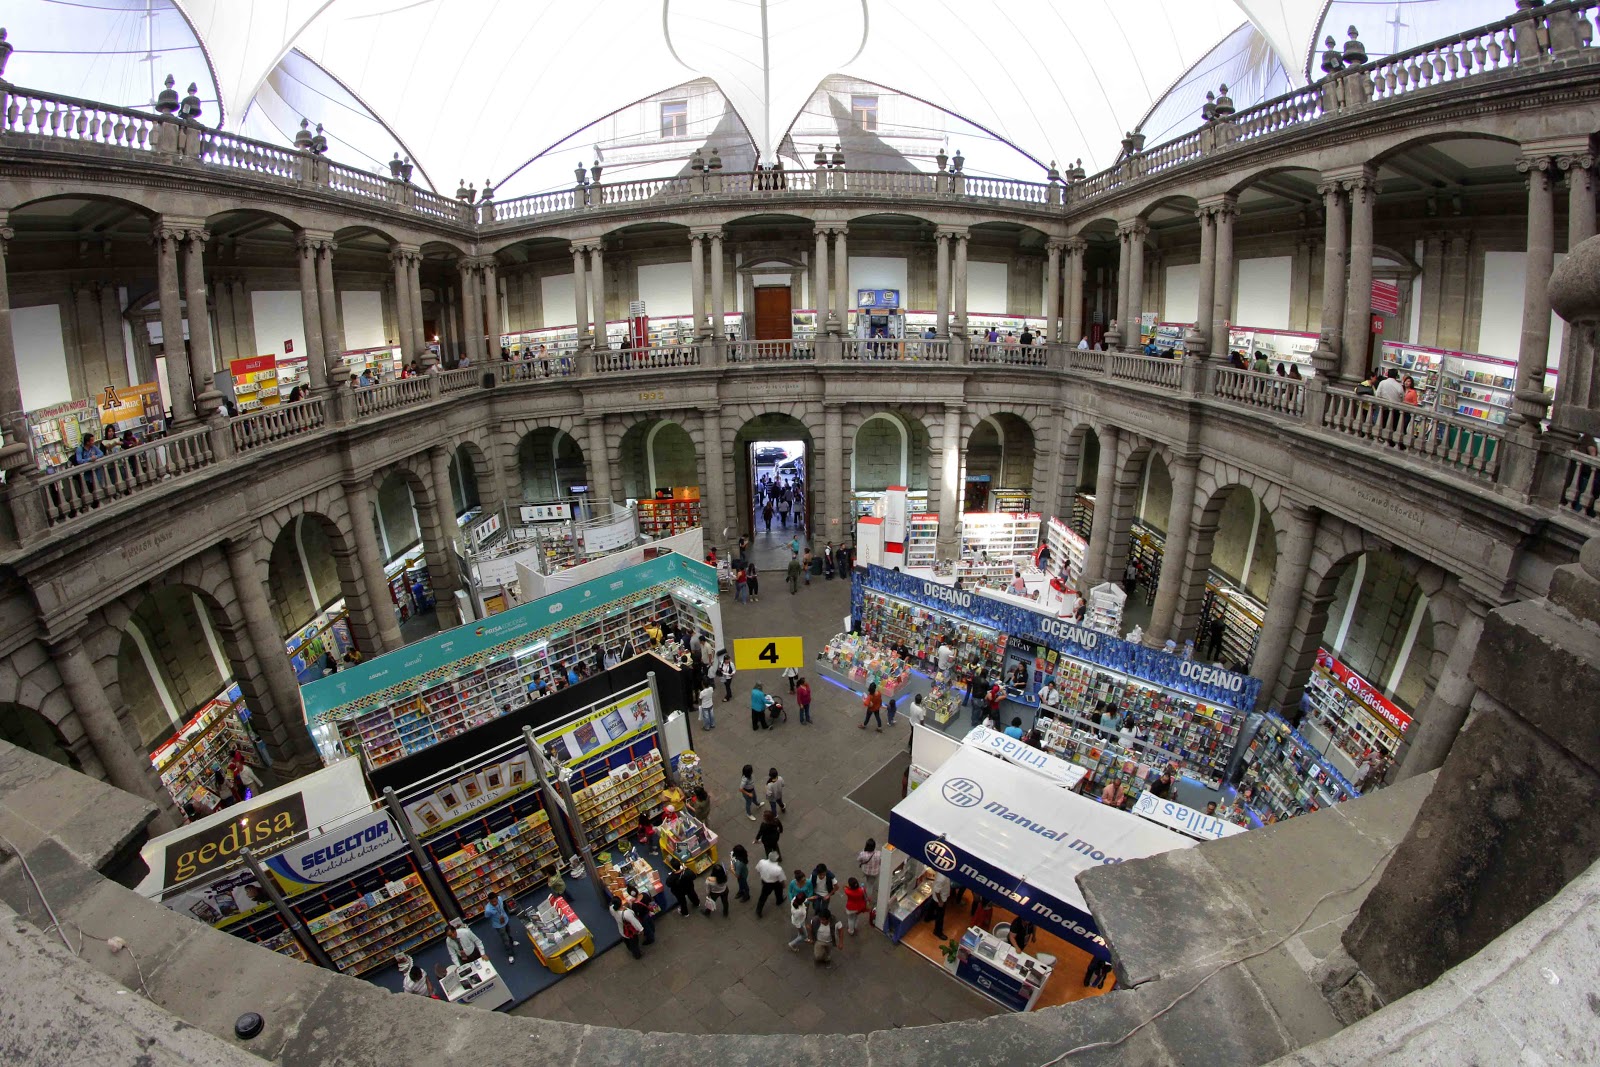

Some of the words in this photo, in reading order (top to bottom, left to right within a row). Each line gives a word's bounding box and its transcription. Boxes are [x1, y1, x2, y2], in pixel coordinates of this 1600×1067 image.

[1374, 321, 1382, 329] 15
[103, 386, 121, 409] A
[923, 582, 971, 608] OCEANO
[484, 626, 502, 636] PRISA
[1023, 633, 1046, 646] CAJA
[1041, 617, 1097, 648] OCEANO
[759, 642, 779, 664] 4
[1180, 661, 1242, 692] OCEANO
[575, 717, 591, 728] BEST
[594, 705, 618, 718] SELLER
[991, 737, 1048, 768] trillas
[453, 809, 462, 817] B.
[464, 791, 500, 811] TRAVEN
[983, 801, 1069, 841] manual
[1163, 803, 1224, 838] trillas
[174, 811, 295, 881] gedisa
[301, 819, 389, 871] SELECTOR
[308, 853, 356, 879] actualidad
[357, 833, 397, 857] editorial
[959, 864, 1030, 906] manual
